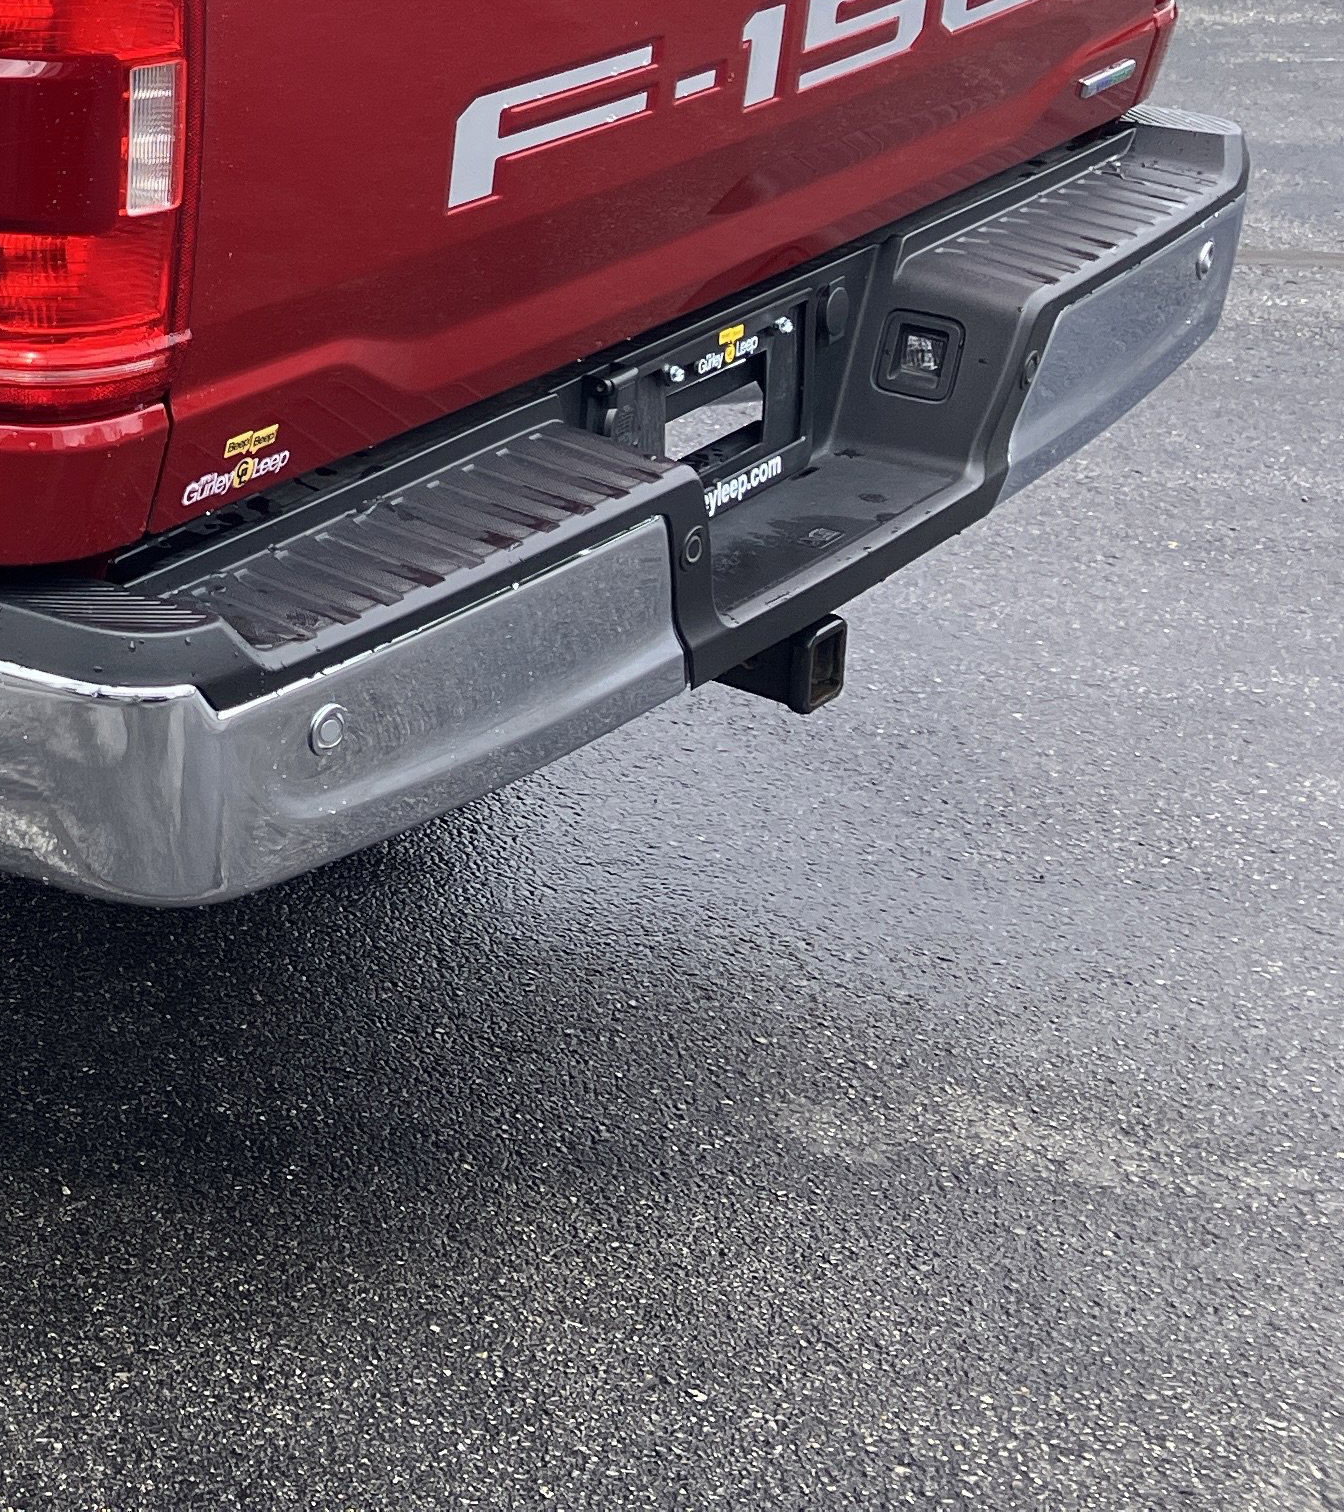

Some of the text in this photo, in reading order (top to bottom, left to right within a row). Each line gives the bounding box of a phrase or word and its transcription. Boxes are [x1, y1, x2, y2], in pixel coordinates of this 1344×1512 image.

[736, 335, 759, 357] Leep
[227, 432, 275, 454] Beep Beep
[181, 472, 235, 506] Gurley
[251, 450, 290, 479] Leep
